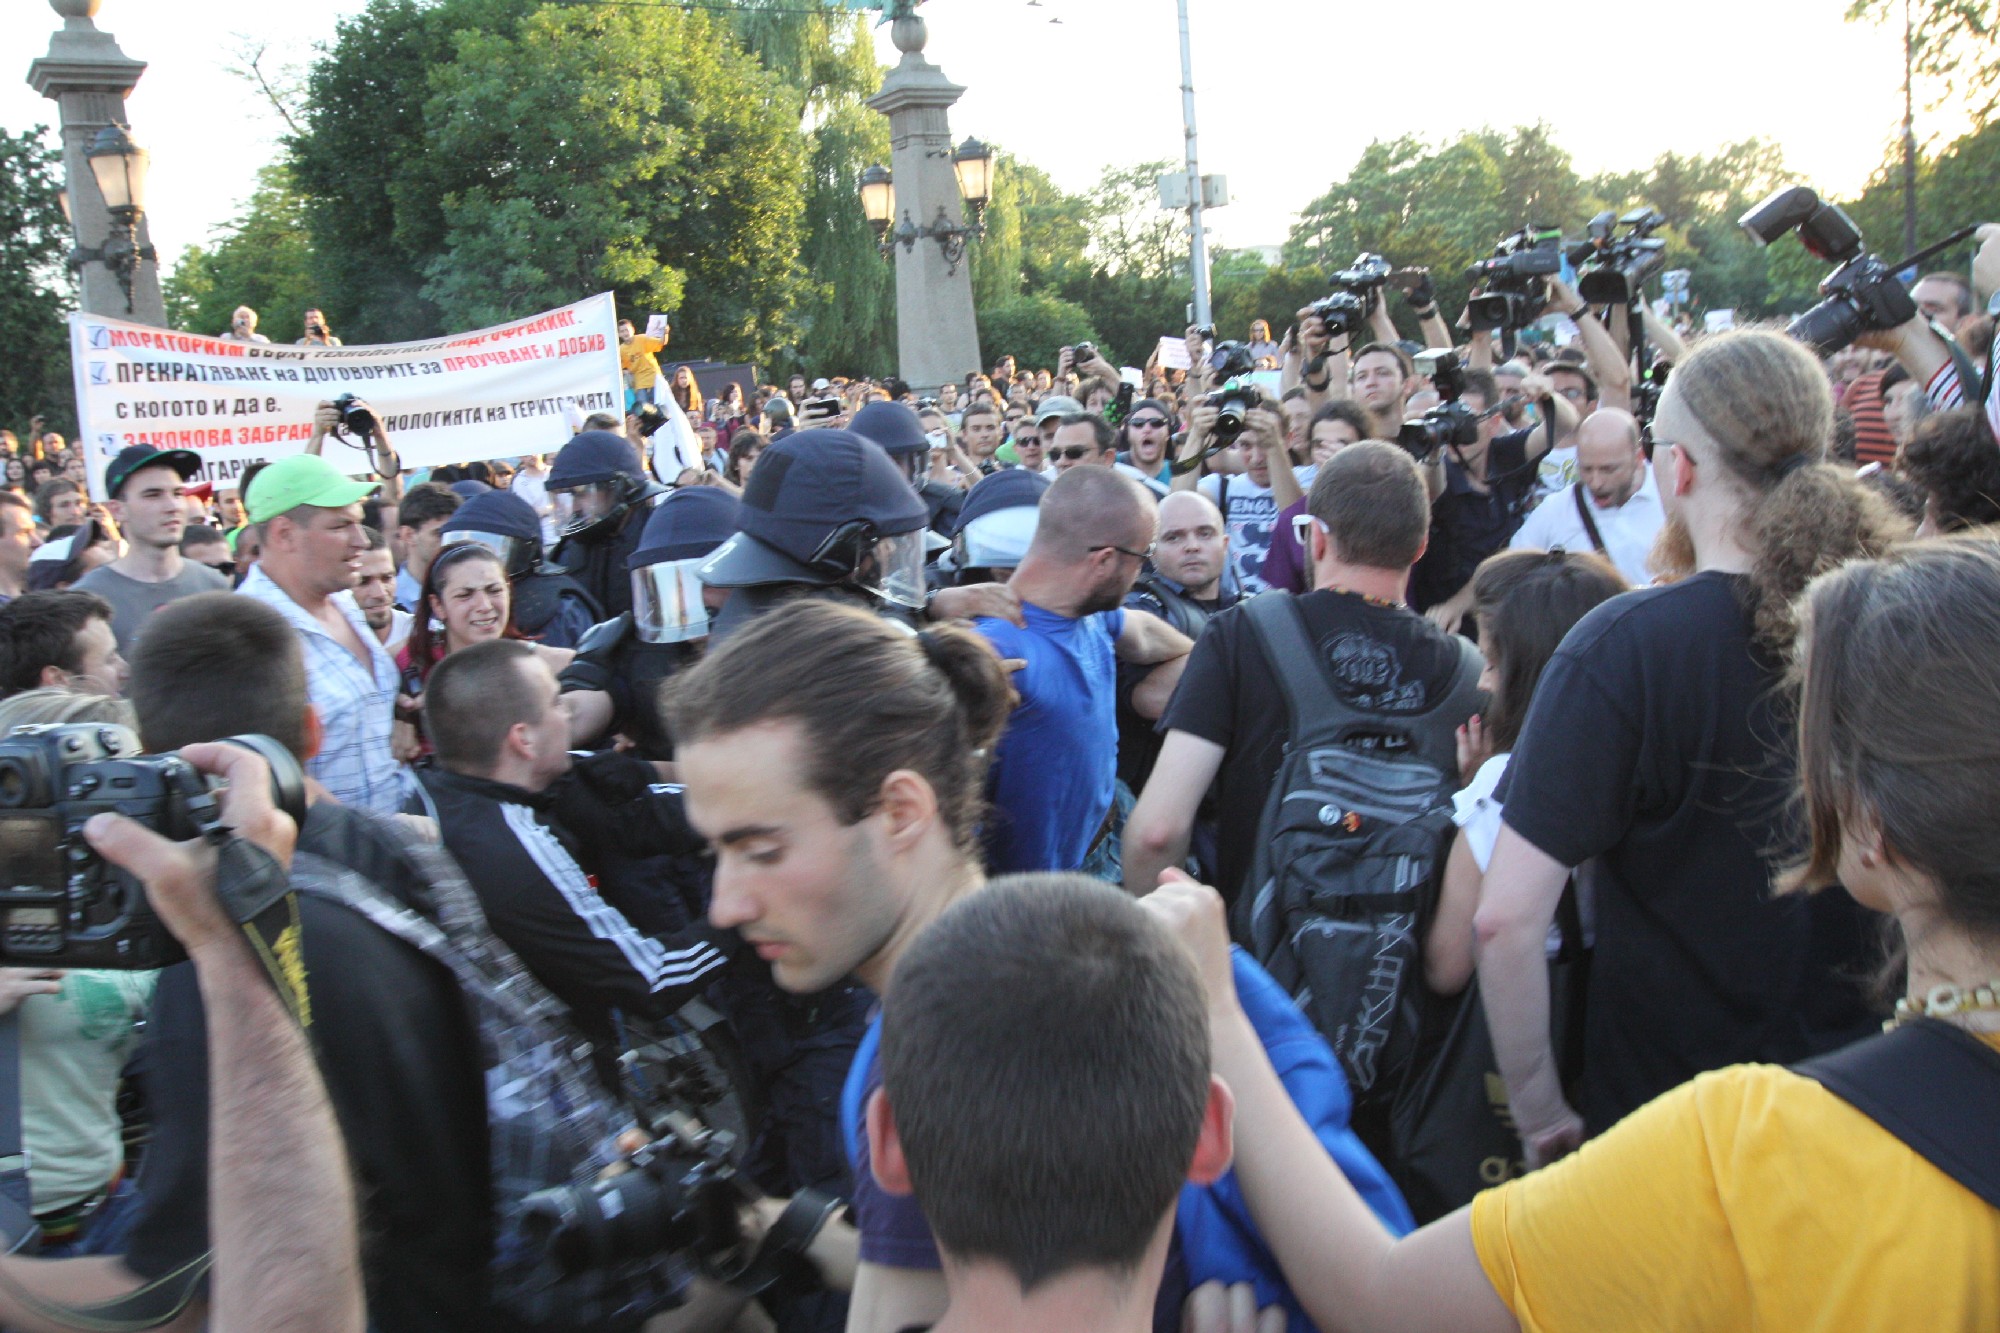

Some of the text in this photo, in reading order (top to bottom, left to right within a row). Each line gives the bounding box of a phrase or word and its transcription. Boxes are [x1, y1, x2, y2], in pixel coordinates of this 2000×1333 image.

[117, 362, 271, 382] ПРЕКРАТЯВАНЕ
[274, 369, 299, 381] на
[304, 363, 418, 384] ДОГОВОРИТЕ
[419, 361, 443, 374] за
[443, 344, 541, 371] ПРОУЧВАНЕ
[558, 333, 606, 359] ДОБИВ
[234, 398, 259, 416] да
[238, 422, 313, 445] ЗАБРАН
[383, 406, 484, 433] НОЛОГИЯТА
[487, 406, 507, 421] на
